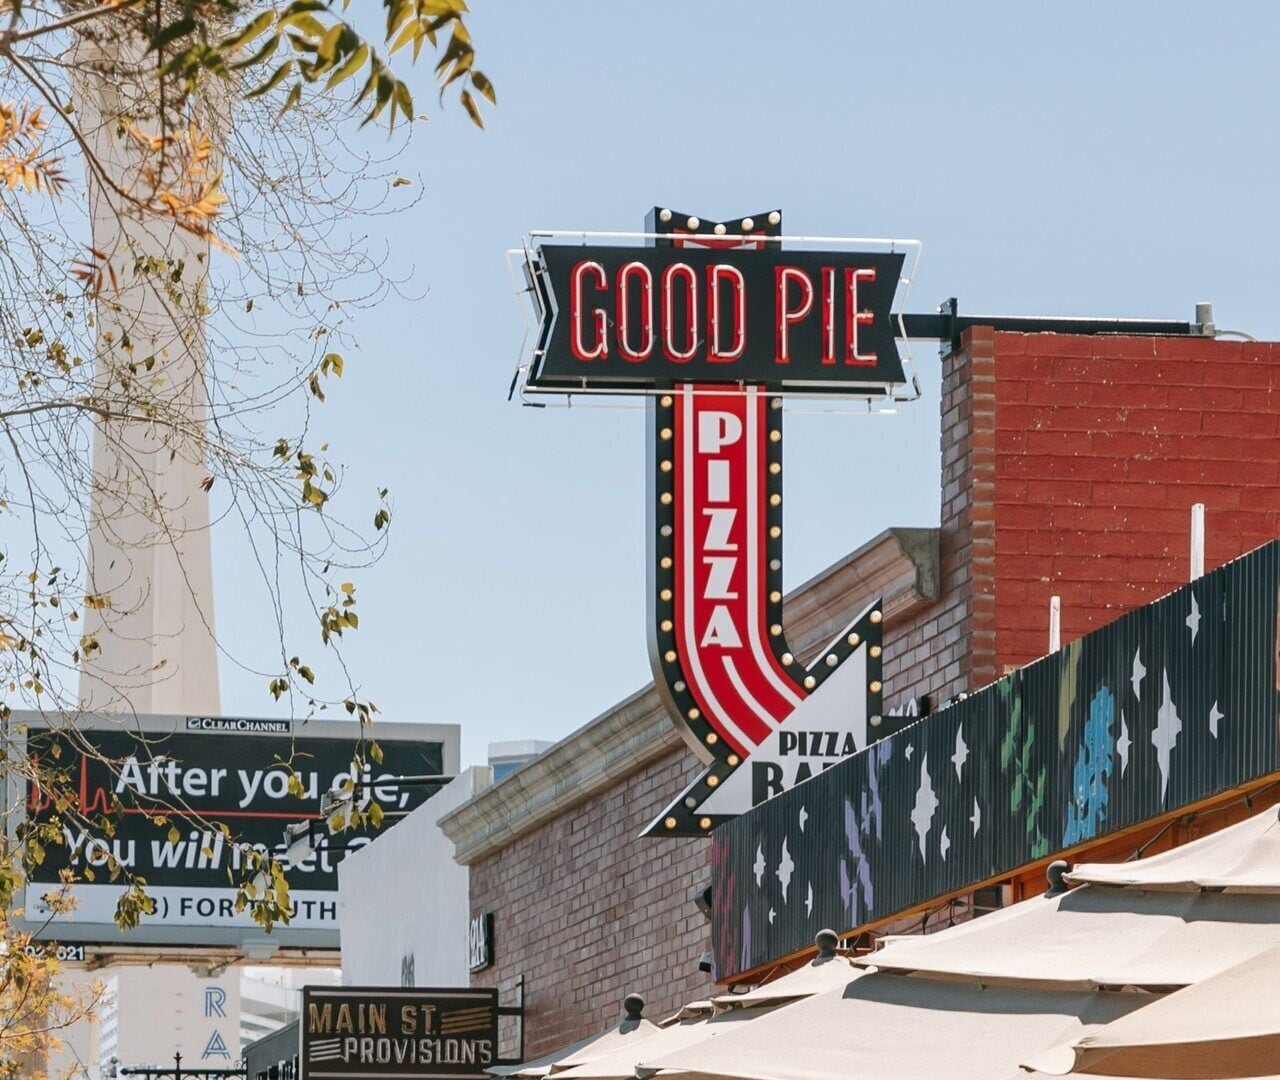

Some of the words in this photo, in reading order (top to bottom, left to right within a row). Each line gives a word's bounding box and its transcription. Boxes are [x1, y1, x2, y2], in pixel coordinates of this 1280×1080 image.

[570, 260, 748, 363] GOOD
[775, 266, 879, 367] PIE
[697, 410, 743, 650] PIZZA
[779, 731, 858, 757] PIZZA
[115, 755, 227, 797] After
[238, 768, 318, 809] you
[63, 829, 136, 868] You
[151, 831, 226, 870] will
[180, 897, 234, 918] FOR
[308, 1003, 387, 1034] MAIN
[401, 1004, 437, 1035] ST.
[342, 1037, 493, 1065] PROVISIONS
